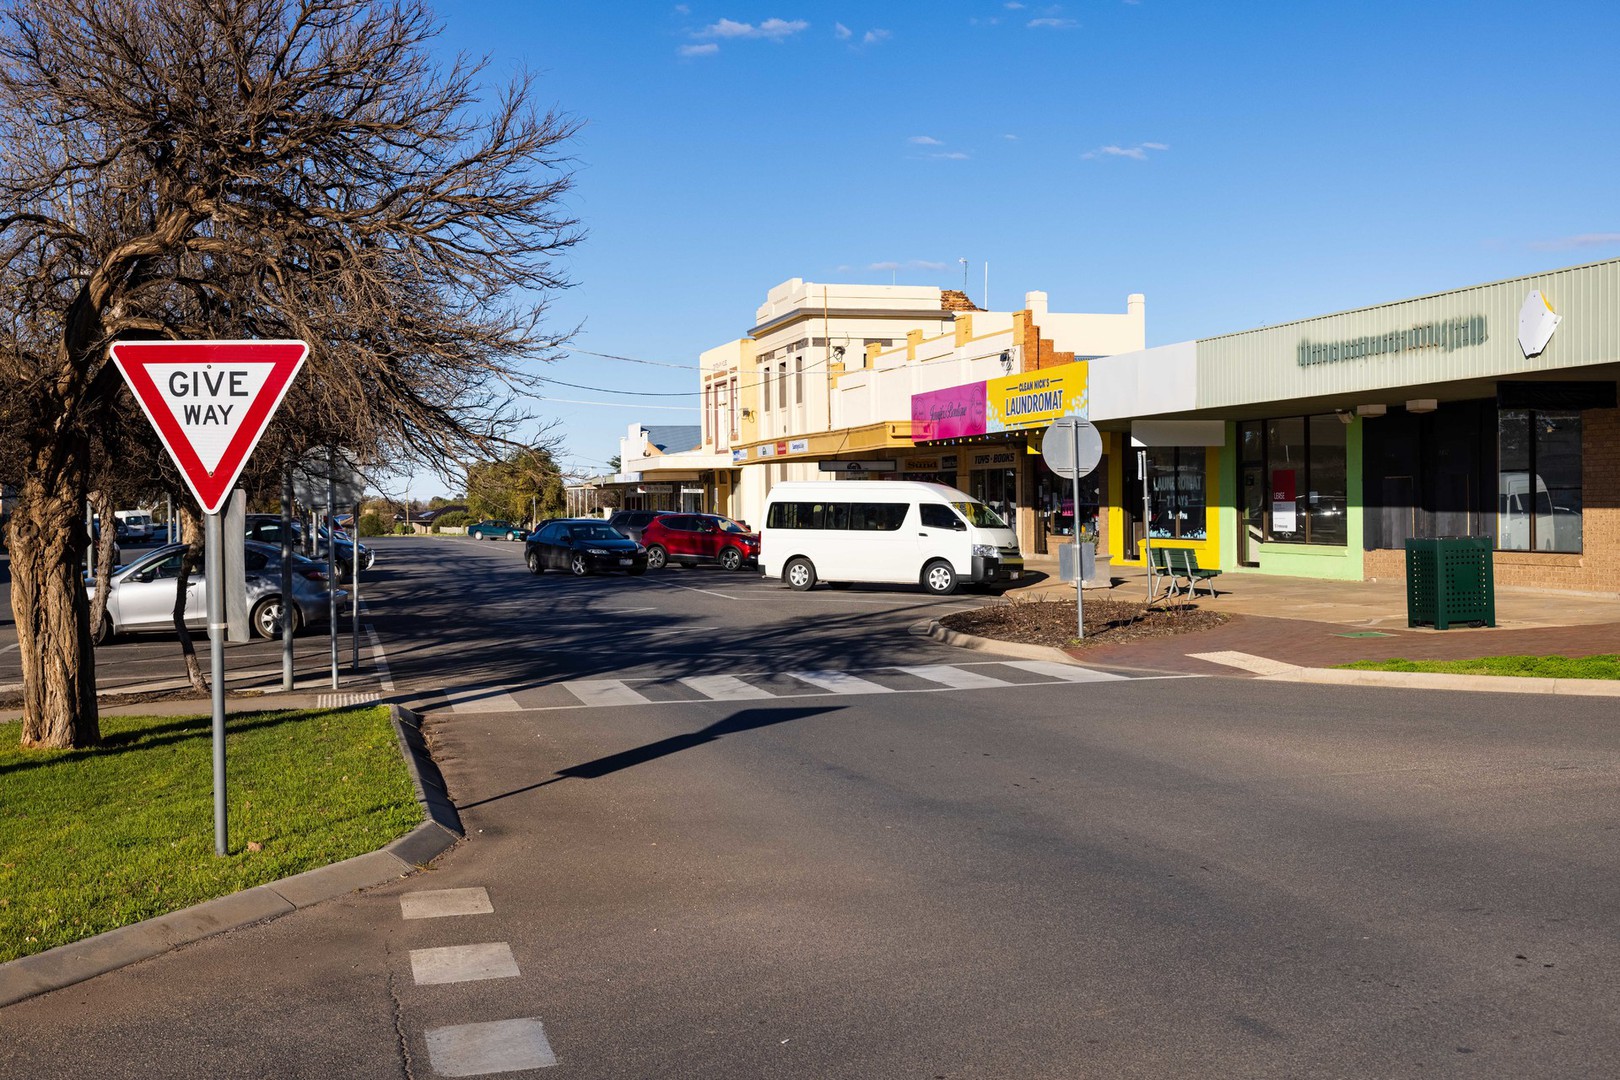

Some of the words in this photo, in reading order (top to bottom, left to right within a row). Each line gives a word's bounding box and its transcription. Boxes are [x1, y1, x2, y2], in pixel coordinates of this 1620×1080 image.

[169, 371, 248, 397] GIVE
[1018, 381, 1033, 392] CLEAN
[1033, 378, 1050, 390] NICK'S
[1005, 390, 1063, 416] LAUNDROMAT
[184, 405, 234, 425] WAY
[974, 454, 990, 464] TOYS
[992, 452, 1015, 463] BOOKS
